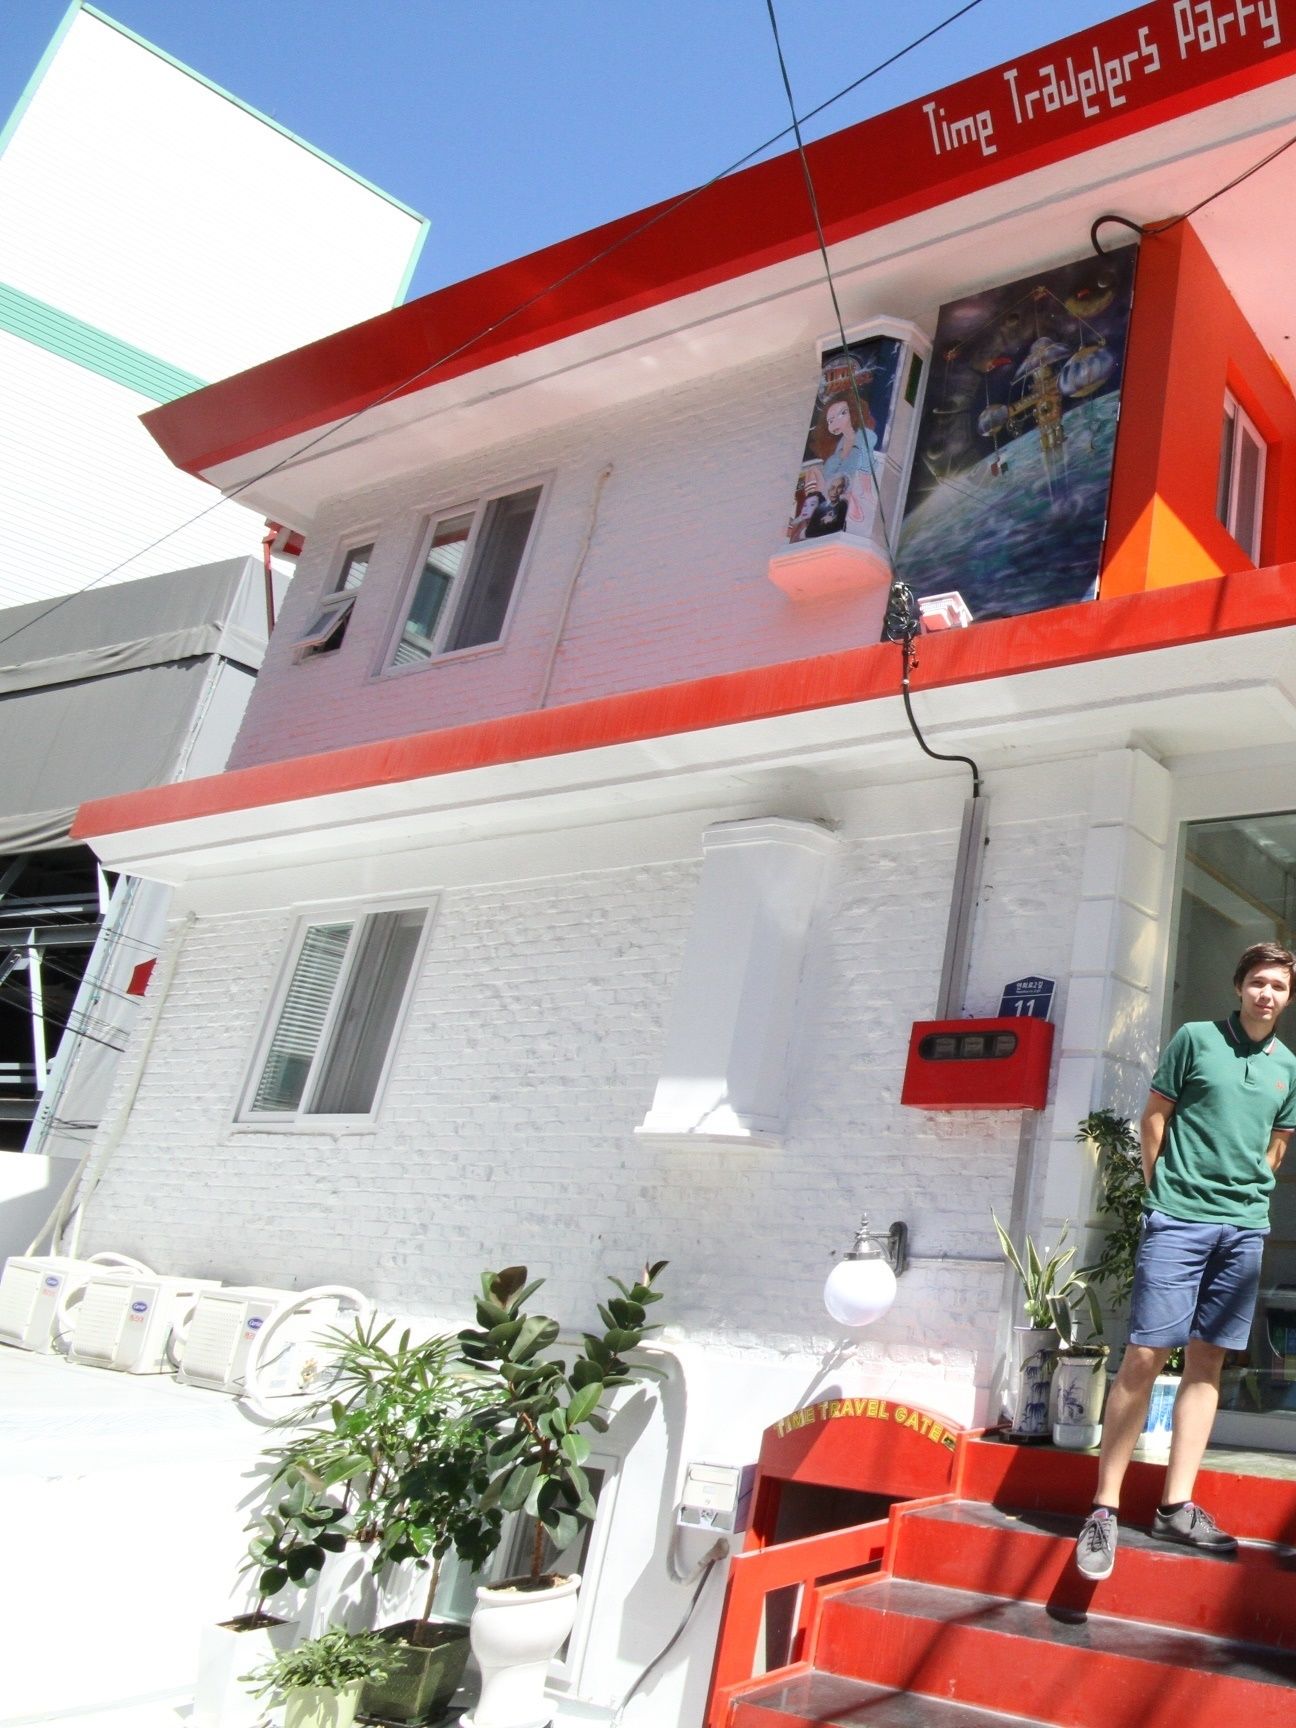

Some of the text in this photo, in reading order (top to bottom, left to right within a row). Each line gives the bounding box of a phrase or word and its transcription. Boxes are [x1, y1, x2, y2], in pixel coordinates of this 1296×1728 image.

[922, 0, 1281, 156] Time Travelers Party
[1014, 999, 1036, 1018] 11
[775, 1399, 945, 1443] TIME TRAVEL GATE
